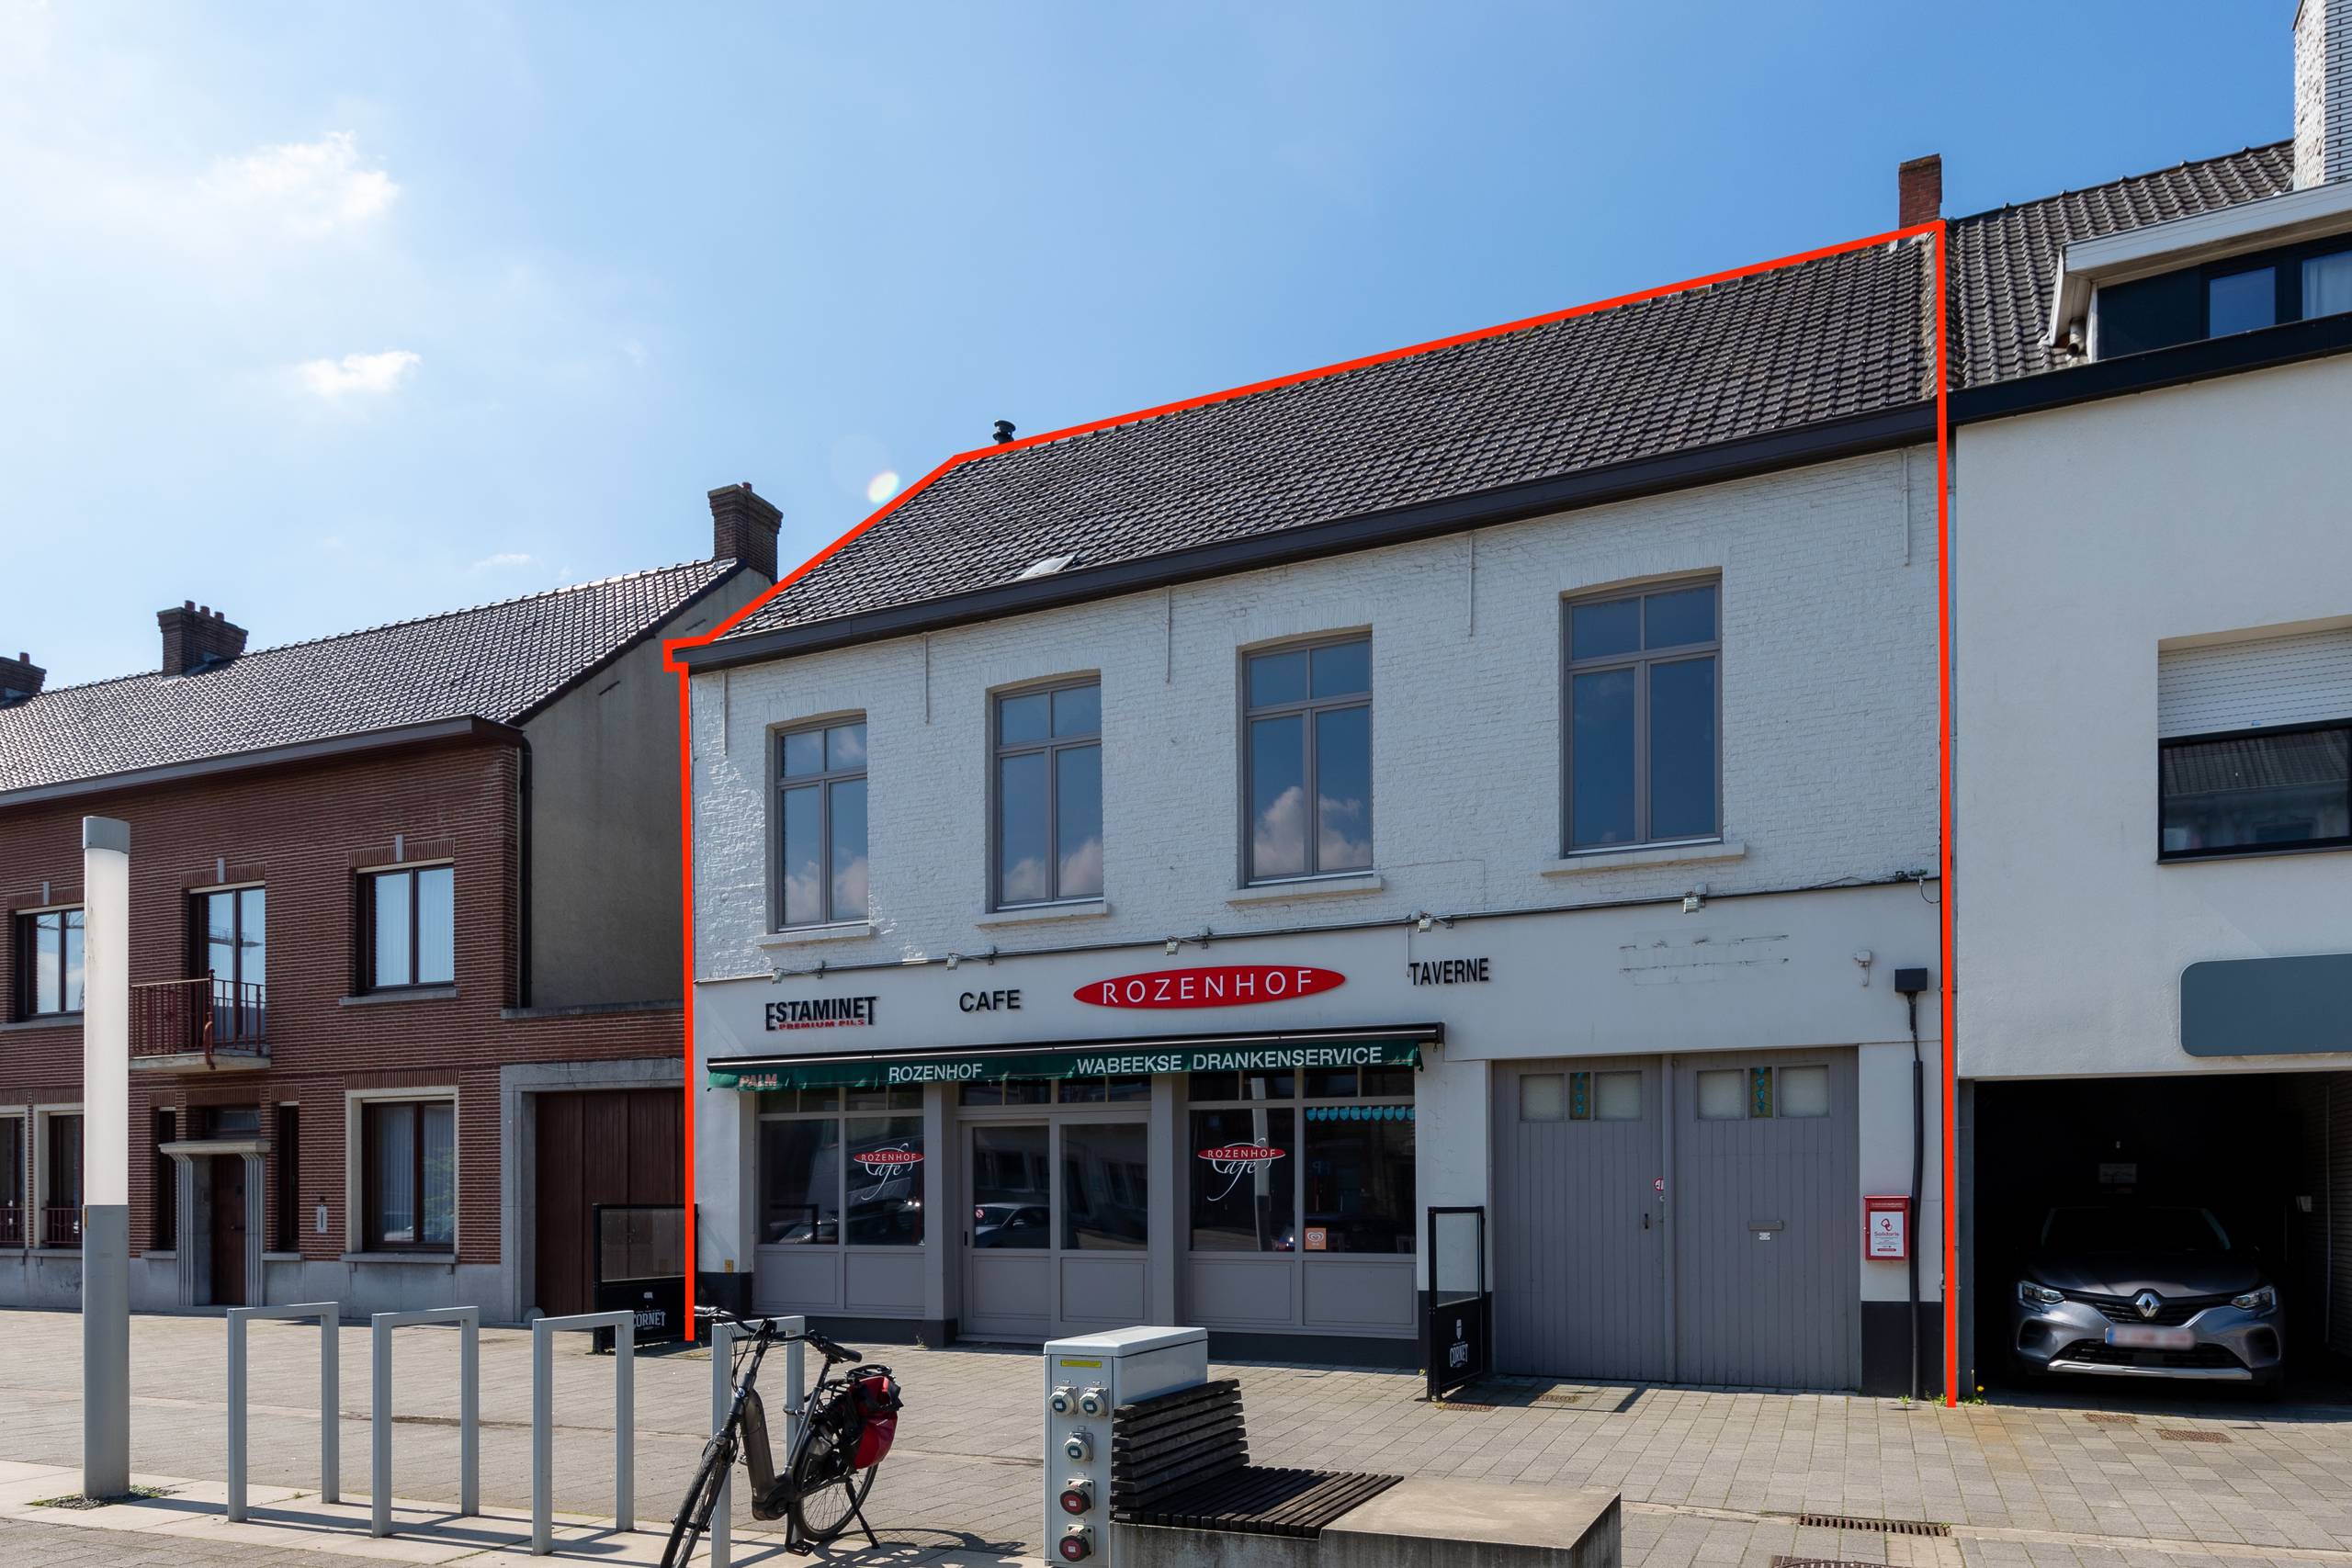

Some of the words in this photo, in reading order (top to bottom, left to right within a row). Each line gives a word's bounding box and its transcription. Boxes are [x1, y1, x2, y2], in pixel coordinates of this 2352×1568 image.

[1408, 957, 1489, 986] TAVERNE
[1102, 969, 1312, 1004] ROZENHOF
[958, 988, 1021, 1013] CAFE
[764, 996, 878, 1032] ESTAMINET
[778, 1021, 835, 1030] PREMIUM
[838, 1019, 865, 1027] PILS
[888, 1063, 983, 1082] ROZENHOF
[1077, 1055, 1182, 1074] WABEEKSE
[1193, 1046, 1383, 1070] DRANKENSERVICE
[738, 1073, 778, 1088] PALM
[861, 1153, 917, 1162] ROZENHOF
[1207, 1148, 1275, 1158] ROZENHOF
